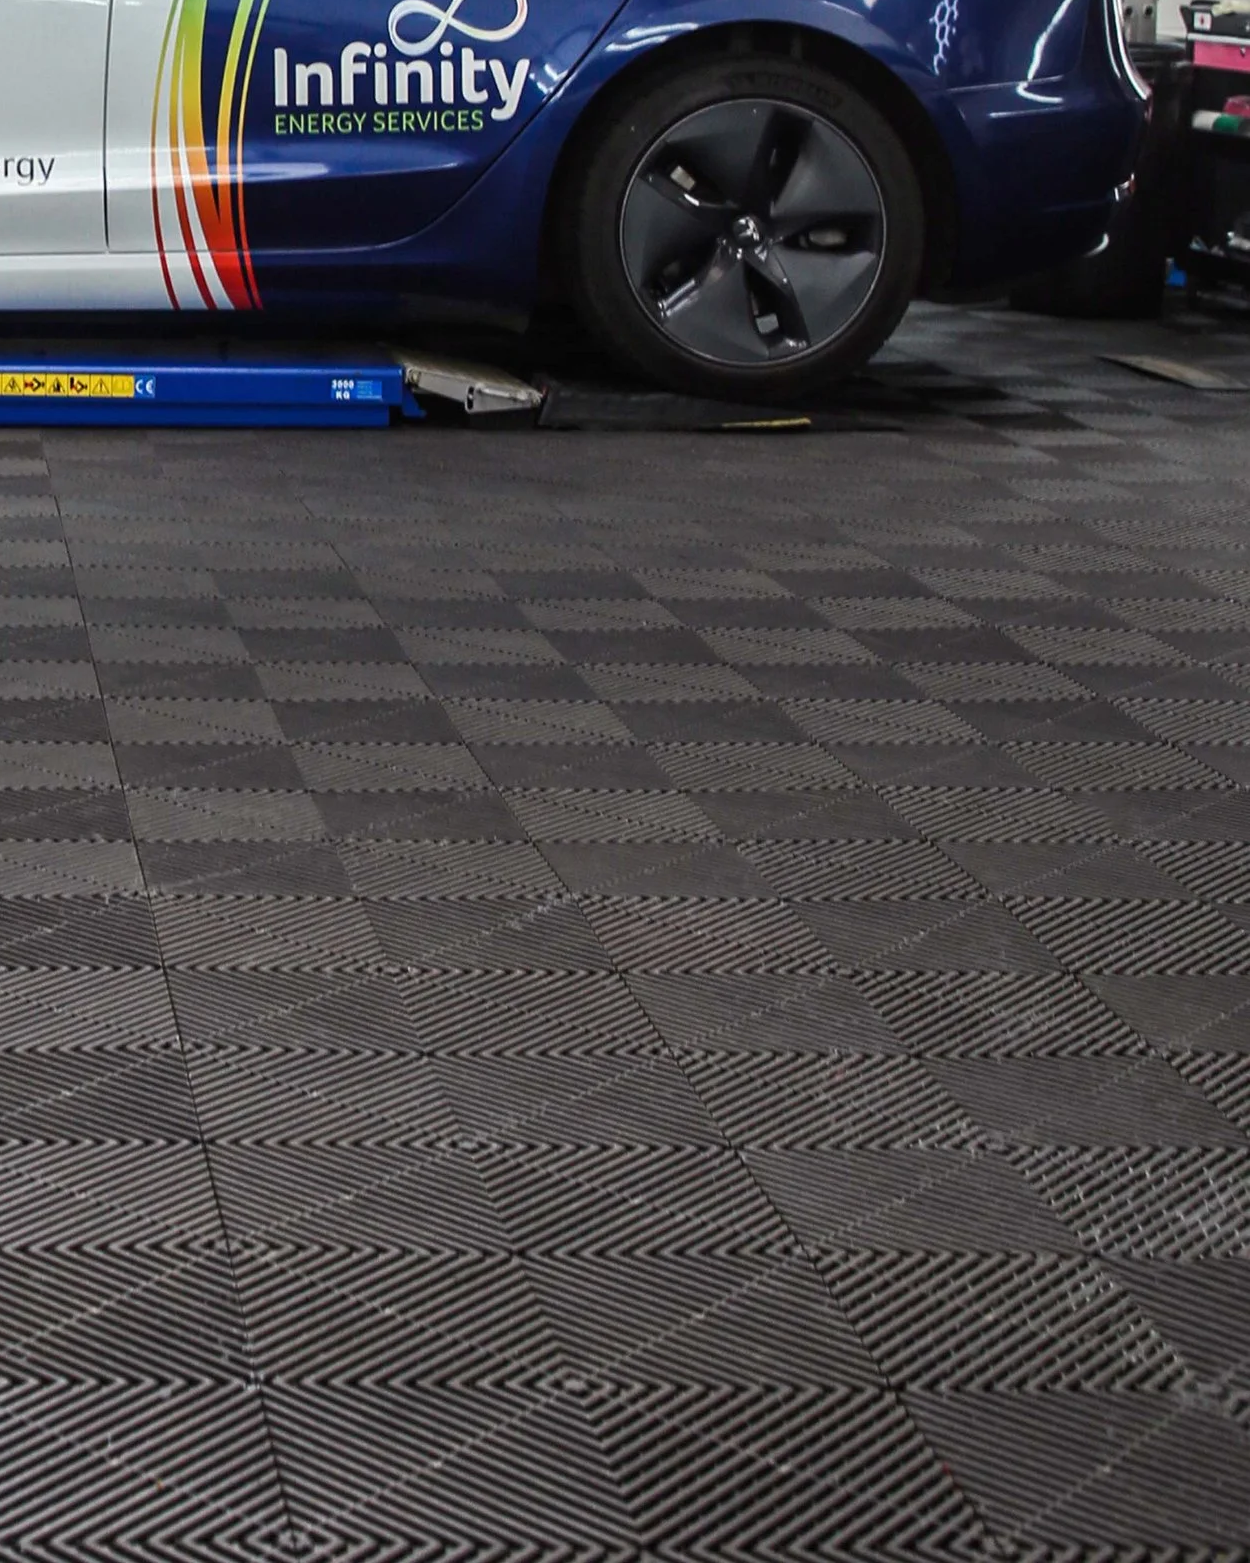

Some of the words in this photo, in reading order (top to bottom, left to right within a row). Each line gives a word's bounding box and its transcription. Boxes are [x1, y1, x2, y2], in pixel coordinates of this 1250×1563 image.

[274, 41, 530, 121] Infinity
[275, 112, 367, 135] ENERGY
[373, 109, 484, 132] SERVICES
[135, 379, 154, 395] CE
